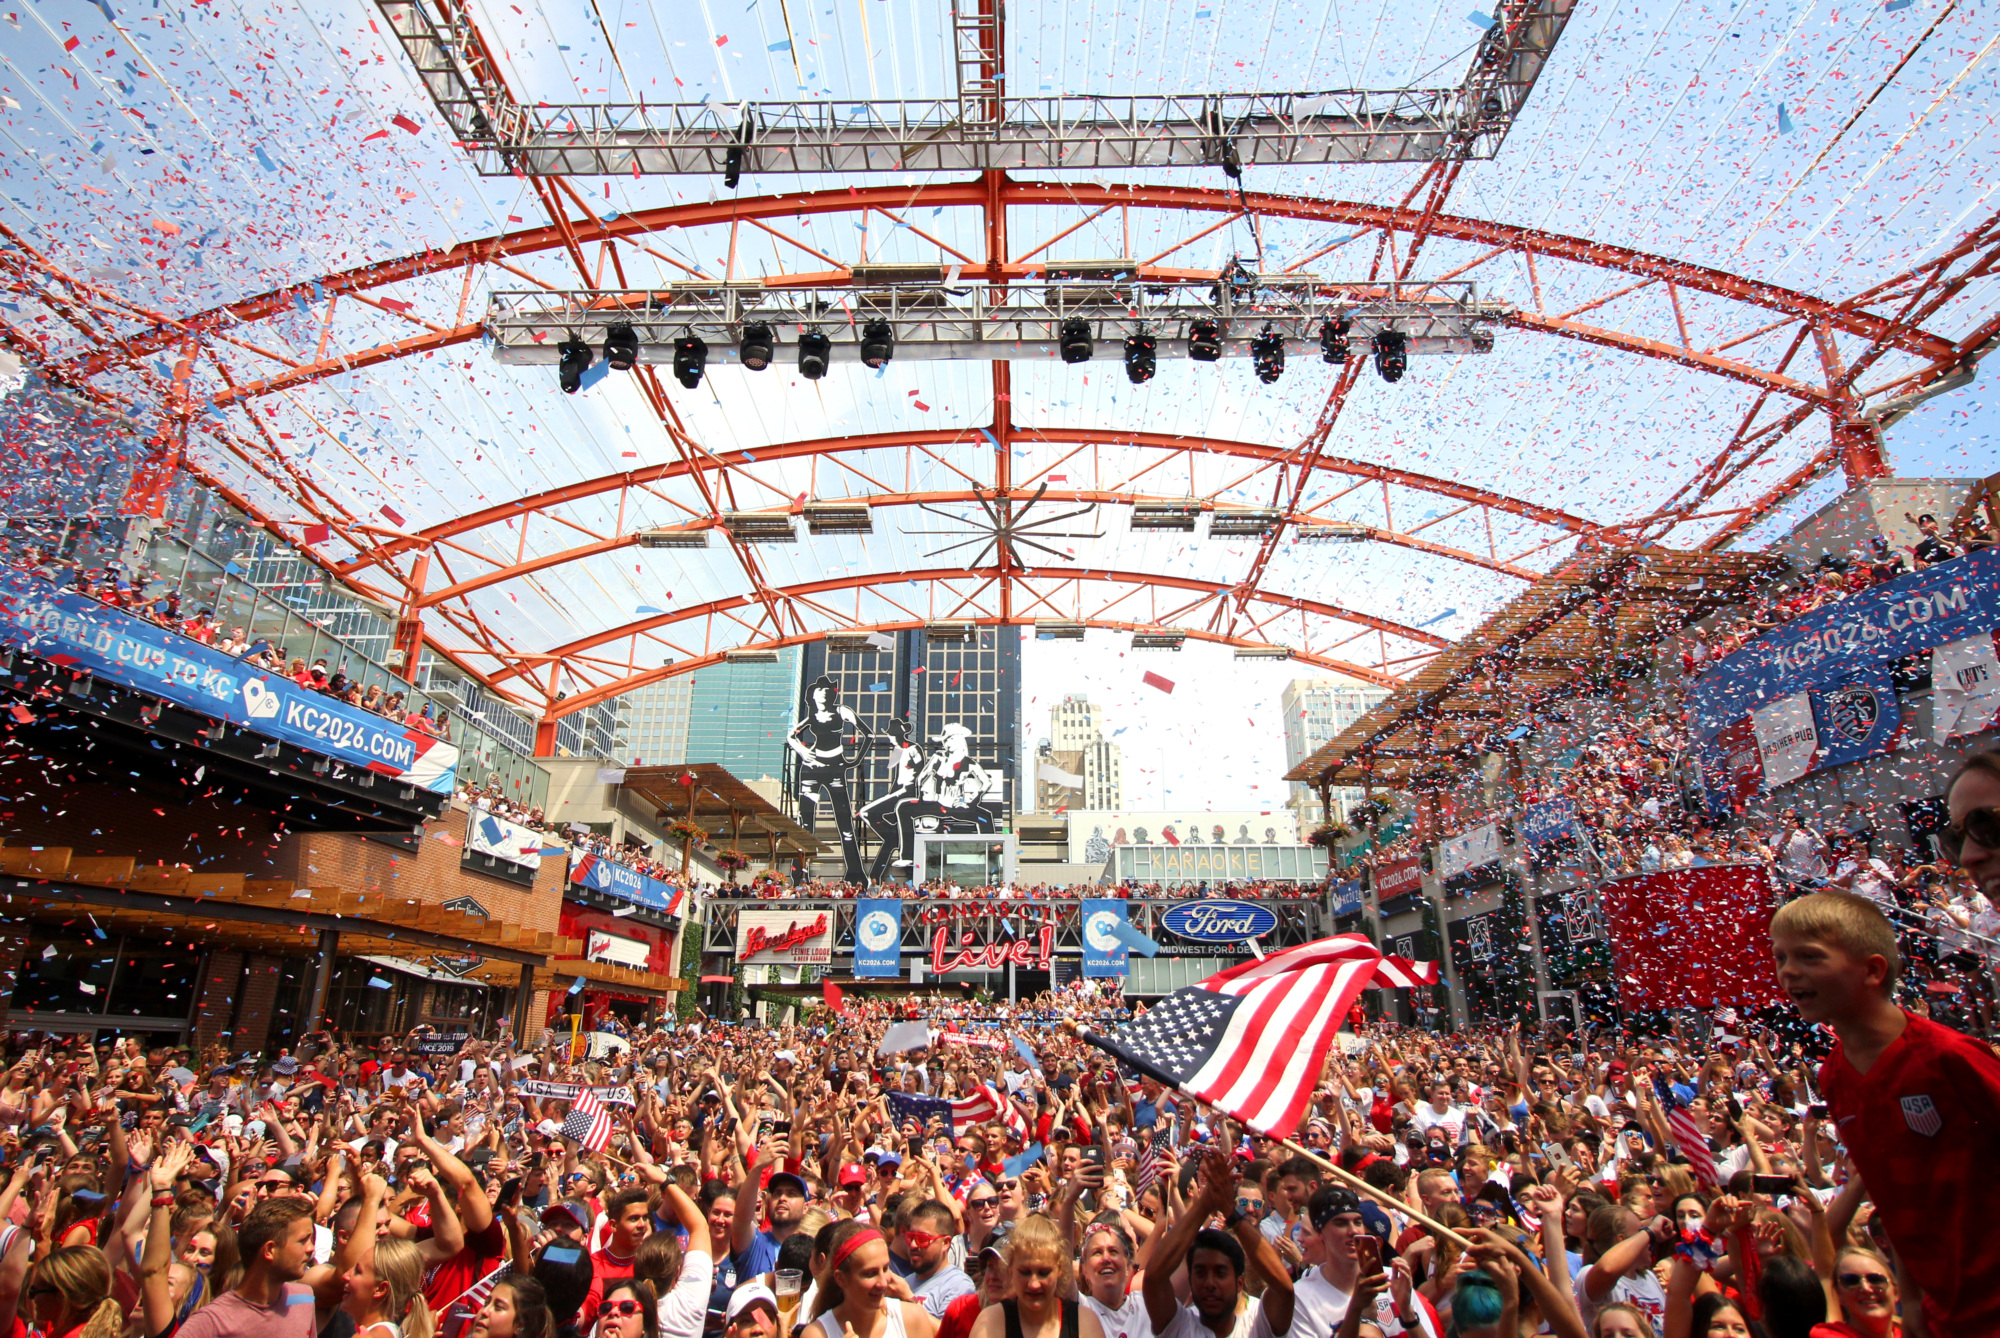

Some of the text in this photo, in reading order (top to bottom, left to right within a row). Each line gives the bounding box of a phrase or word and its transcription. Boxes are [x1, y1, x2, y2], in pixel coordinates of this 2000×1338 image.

[1777, 584, 1968, 675] KC2026.COM
[117, 638, 166, 670] CUP
[172, 657, 199, 684] TO
[286, 700, 412, 766] KC2026.COM
[1794, 727, 1814, 743] PUB
[1153, 853, 1260, 870] KARAOKE
[615, 868, 642, 889] KC2026
[1380, 865, 1418, 890] KC2026.COM
[922, 902, 1010, 925] KANSAS
[1184, 904, 1256, 935] Ford
[791, 947, 831, 955] LEINIE LODGE
[931, 925, 1053, 975] Live!
[1159, 945, 1205, 954] MIDWEST
[1208, 945, 1236, 954] FORD
[526, 1081, 553, 1096] USA
[607, 1087, 632, 1102] USA
[1903, 1096, 1931, 1115] USA
